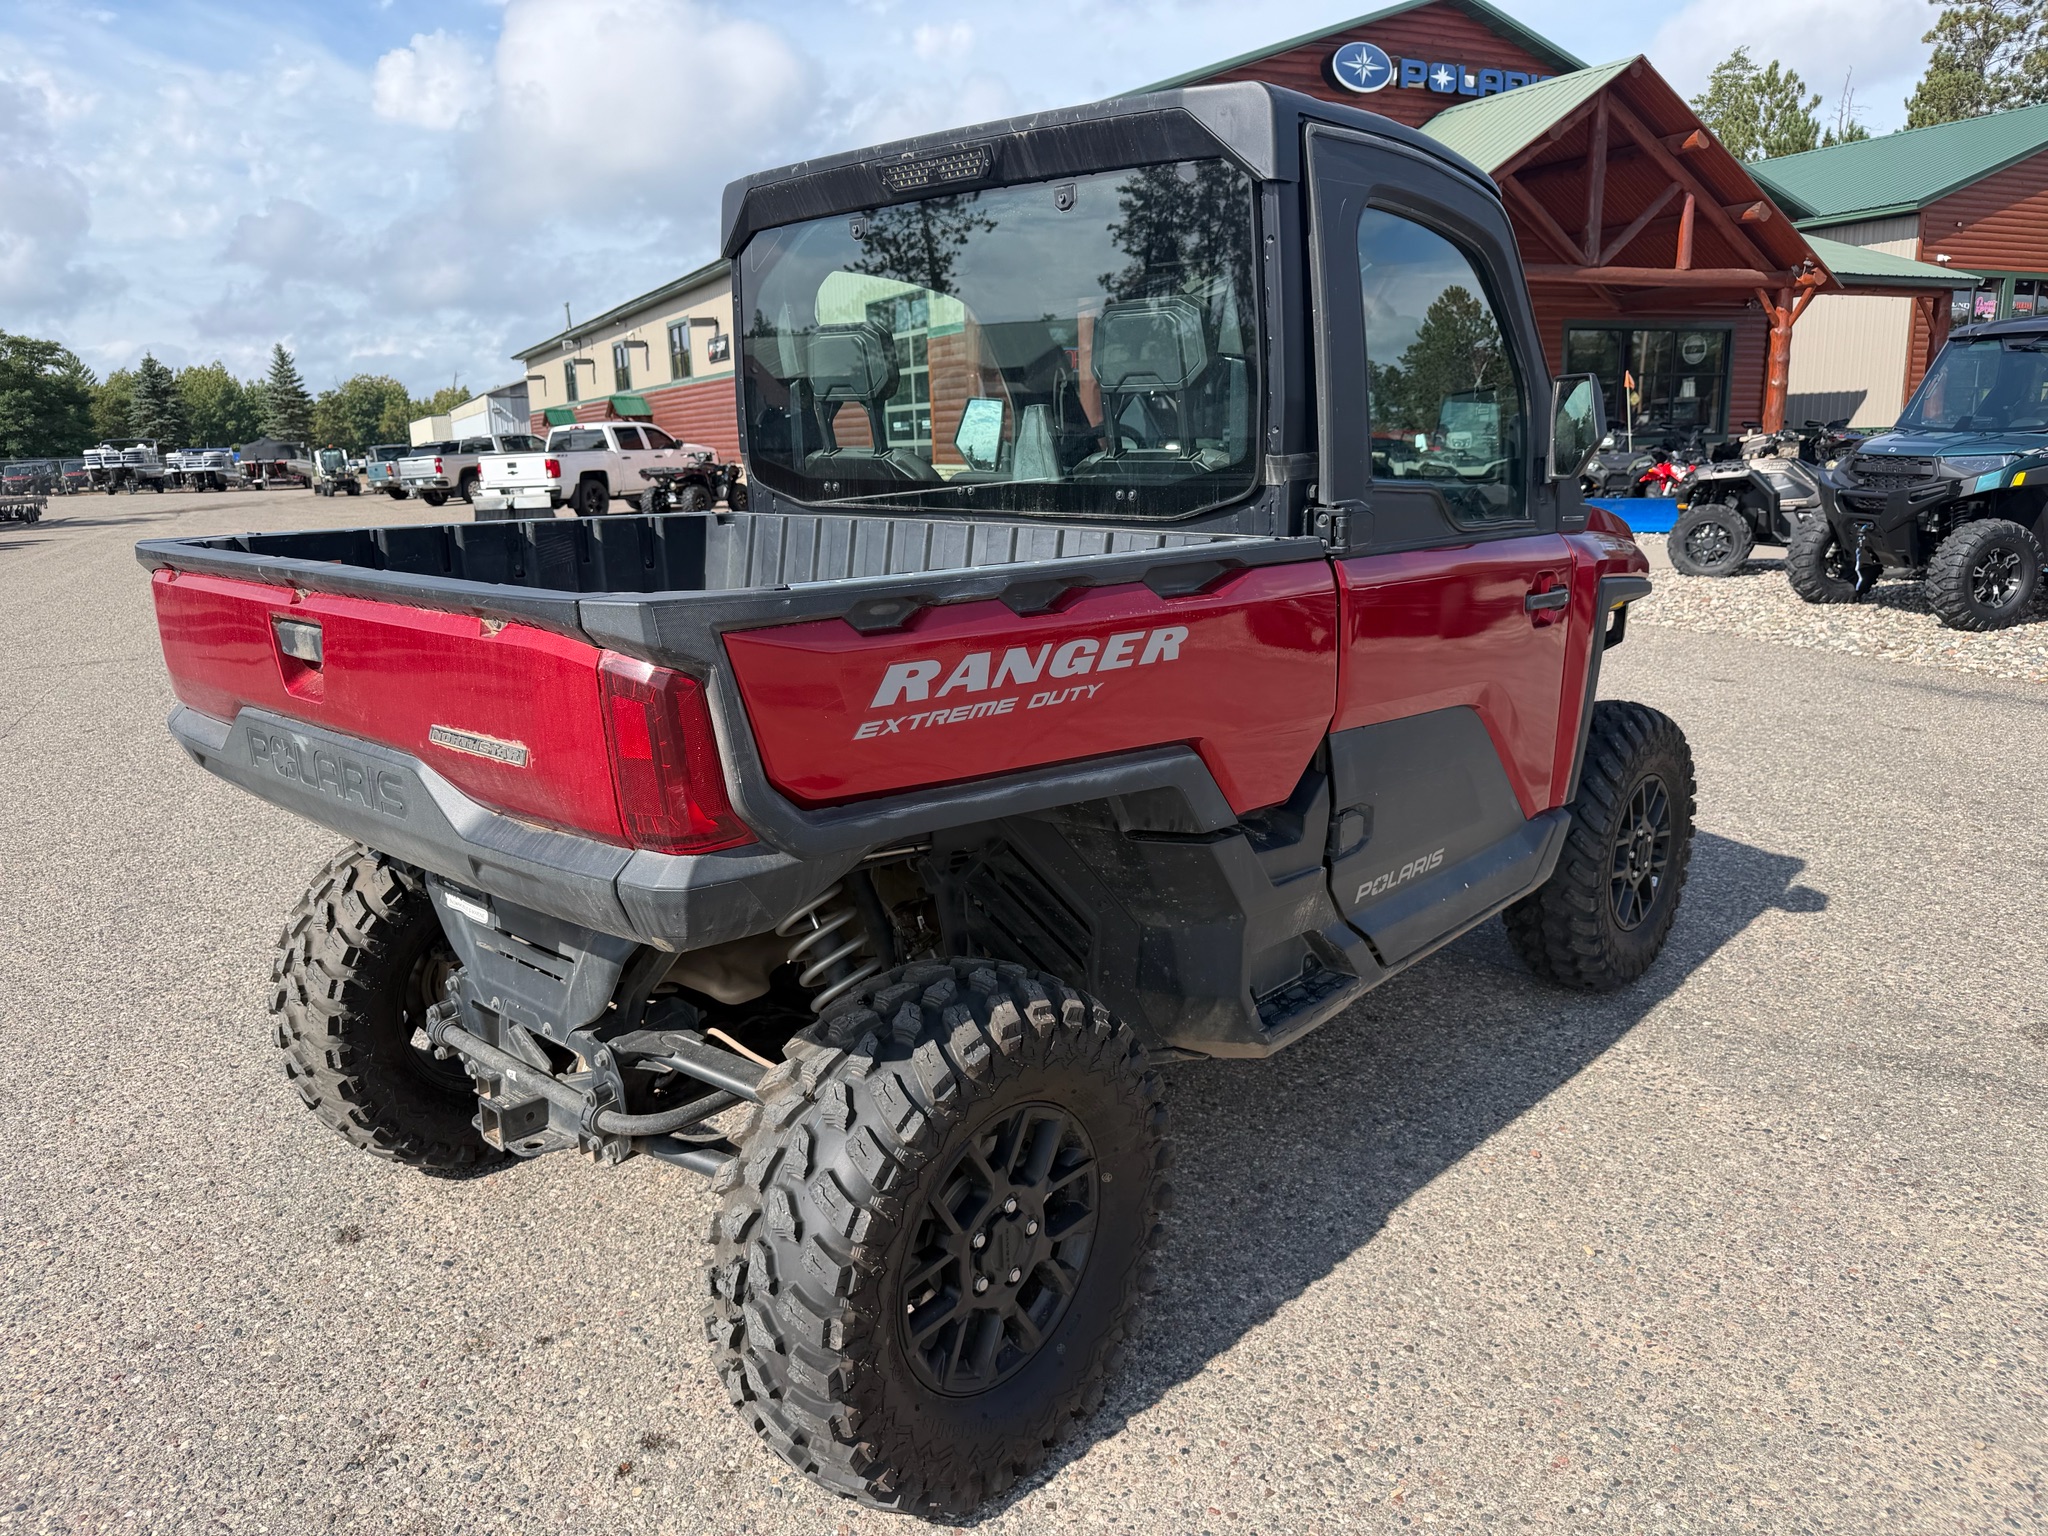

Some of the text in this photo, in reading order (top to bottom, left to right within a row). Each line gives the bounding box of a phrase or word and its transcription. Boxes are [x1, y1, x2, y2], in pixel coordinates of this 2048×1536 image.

[869, 626, 1190, 709] RANGER
[853, 682, 1104, 740] EXTREME DUTY
[246, 727, 408, 821] POLARIS
[431, 728, 526, 763] NORTHSTAR
[1354, 847, 1445, 904] POLARIS
